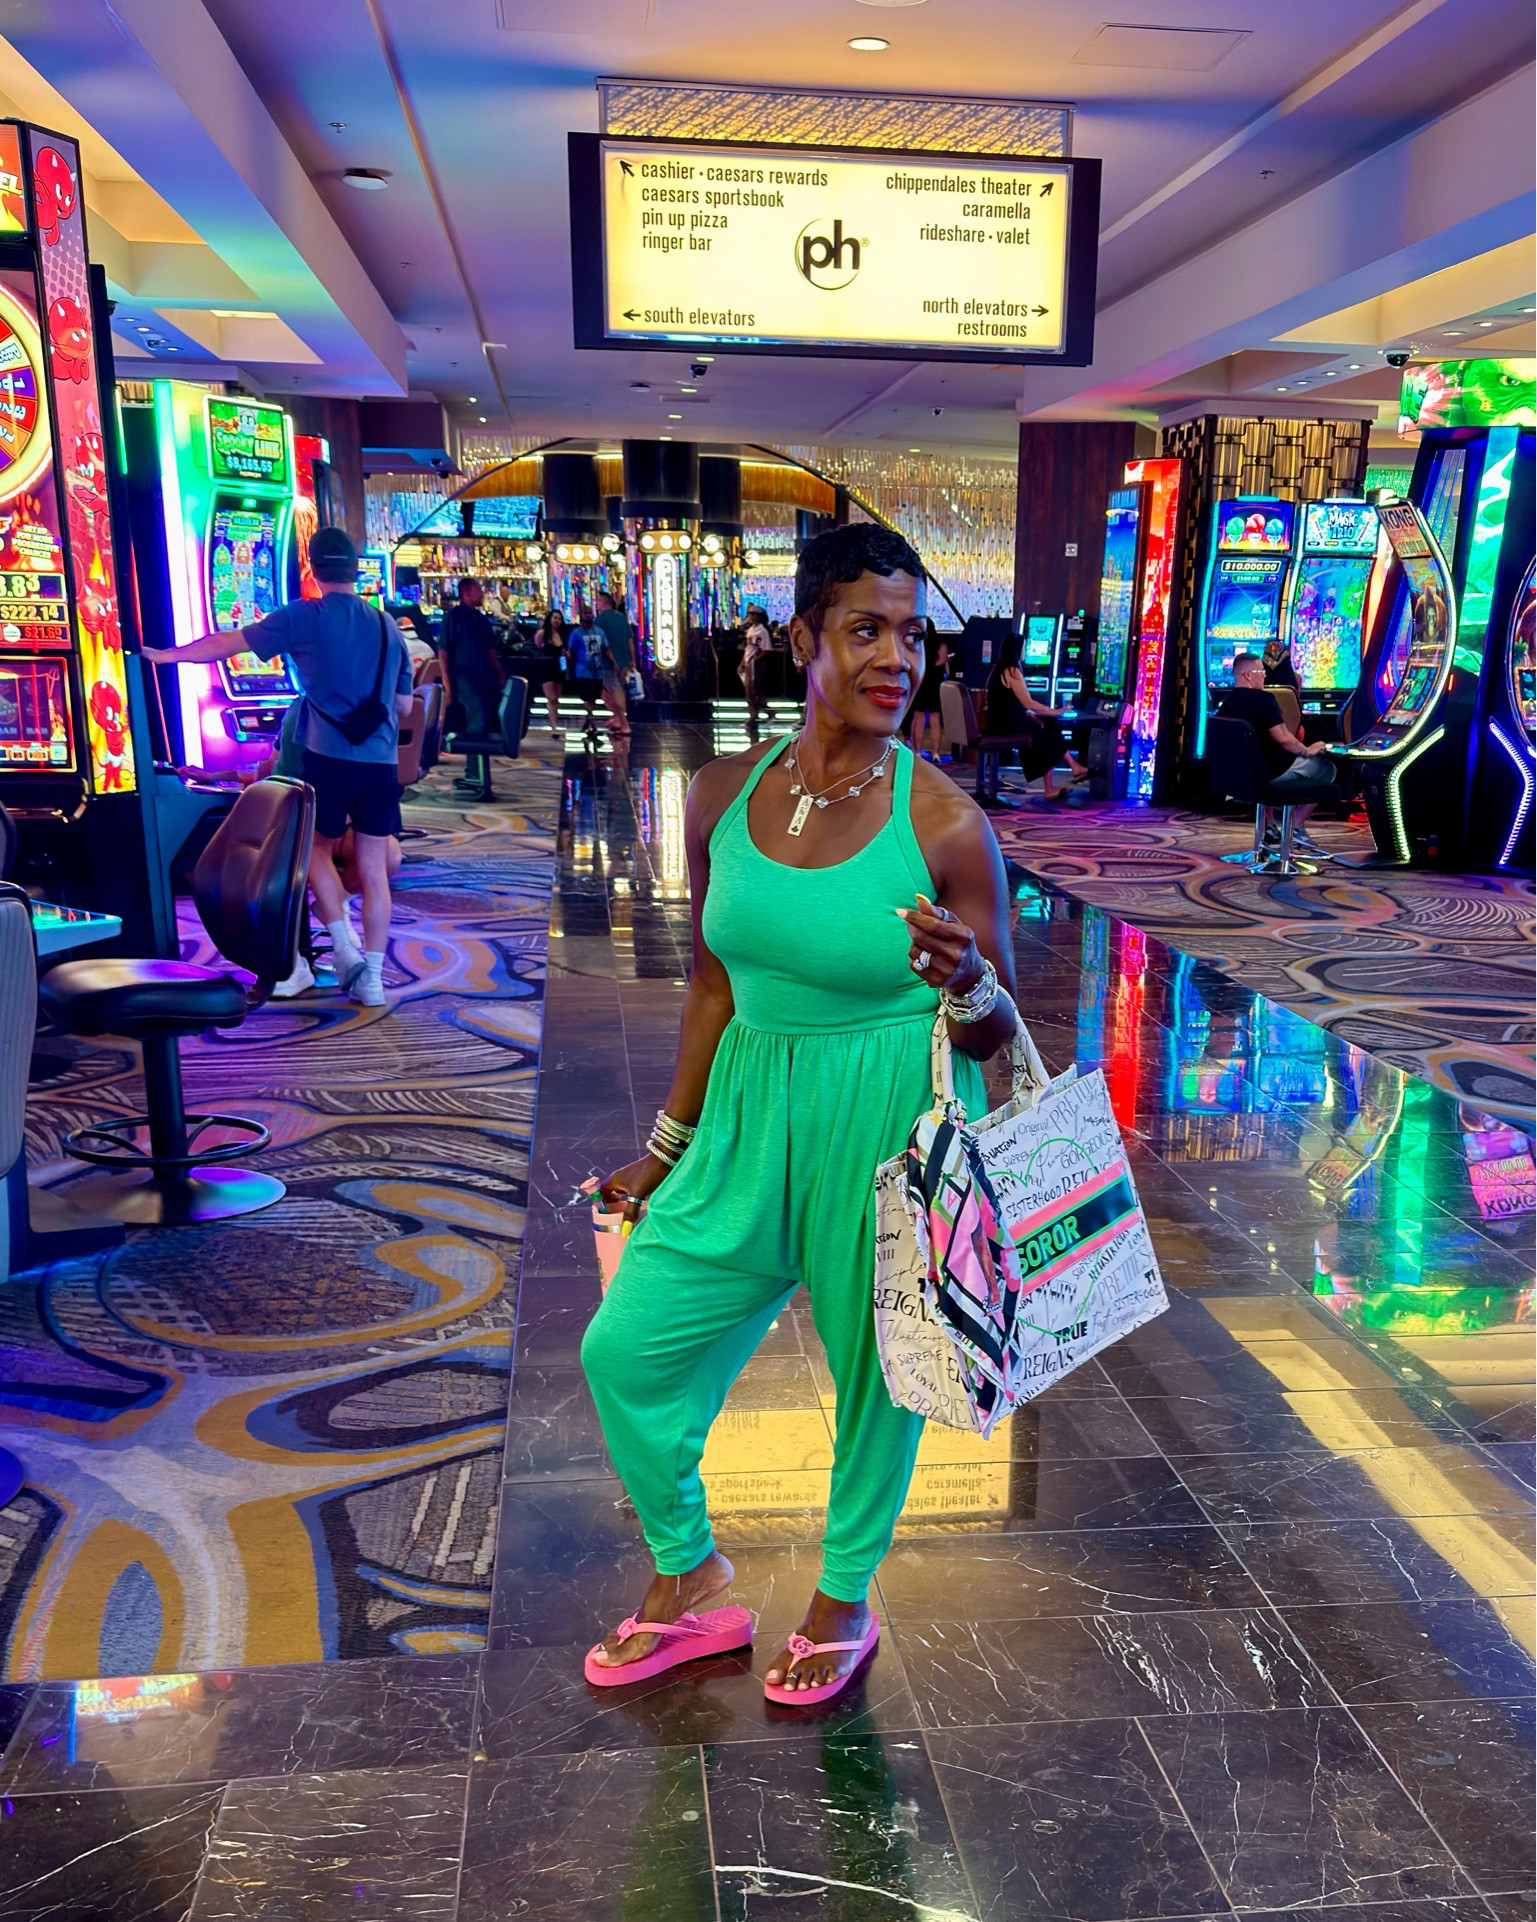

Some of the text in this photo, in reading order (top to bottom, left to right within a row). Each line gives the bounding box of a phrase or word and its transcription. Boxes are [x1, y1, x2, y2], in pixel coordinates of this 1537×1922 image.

[641, 161, 828, 187] cashier caesars rewards
[886, 172, 1032, 196] chippendales theater
[642, 187, 785, 209] caesars sportsbook
[642, 208, 728, 231] pin up pizza
[962, 202, 1031, 220] caramella
[642, 231, 712, 254] ringer bar
[920, 223, 1031, 245] rideshare valet
[644, 306, 756, 327] south elevators
[923, 297, 1028, 317] north elevators
[957, 320, 1028, 338] restrooms
[1327, 511, 1358, 528] MAGIC
[1380, 508, 1415, 530] KONG
[1329, 525, 1355, 540] TRIO
[0, 604, 59, 620] $222.14
[1017, 1117, 1049, 1136] Original
[1060, 1128, 1113, 1169] GORGEOUS
[1005, 1185, 1061, 1218] SISTERHOOD
[1016, 1215, 1081, 1275] SOROR
[1053, 1320, 1088, 1347] TRUE
[896, 1349, 943, 1367] SUPREME
[1022, 1346, 1077, 1381] REIGNS
